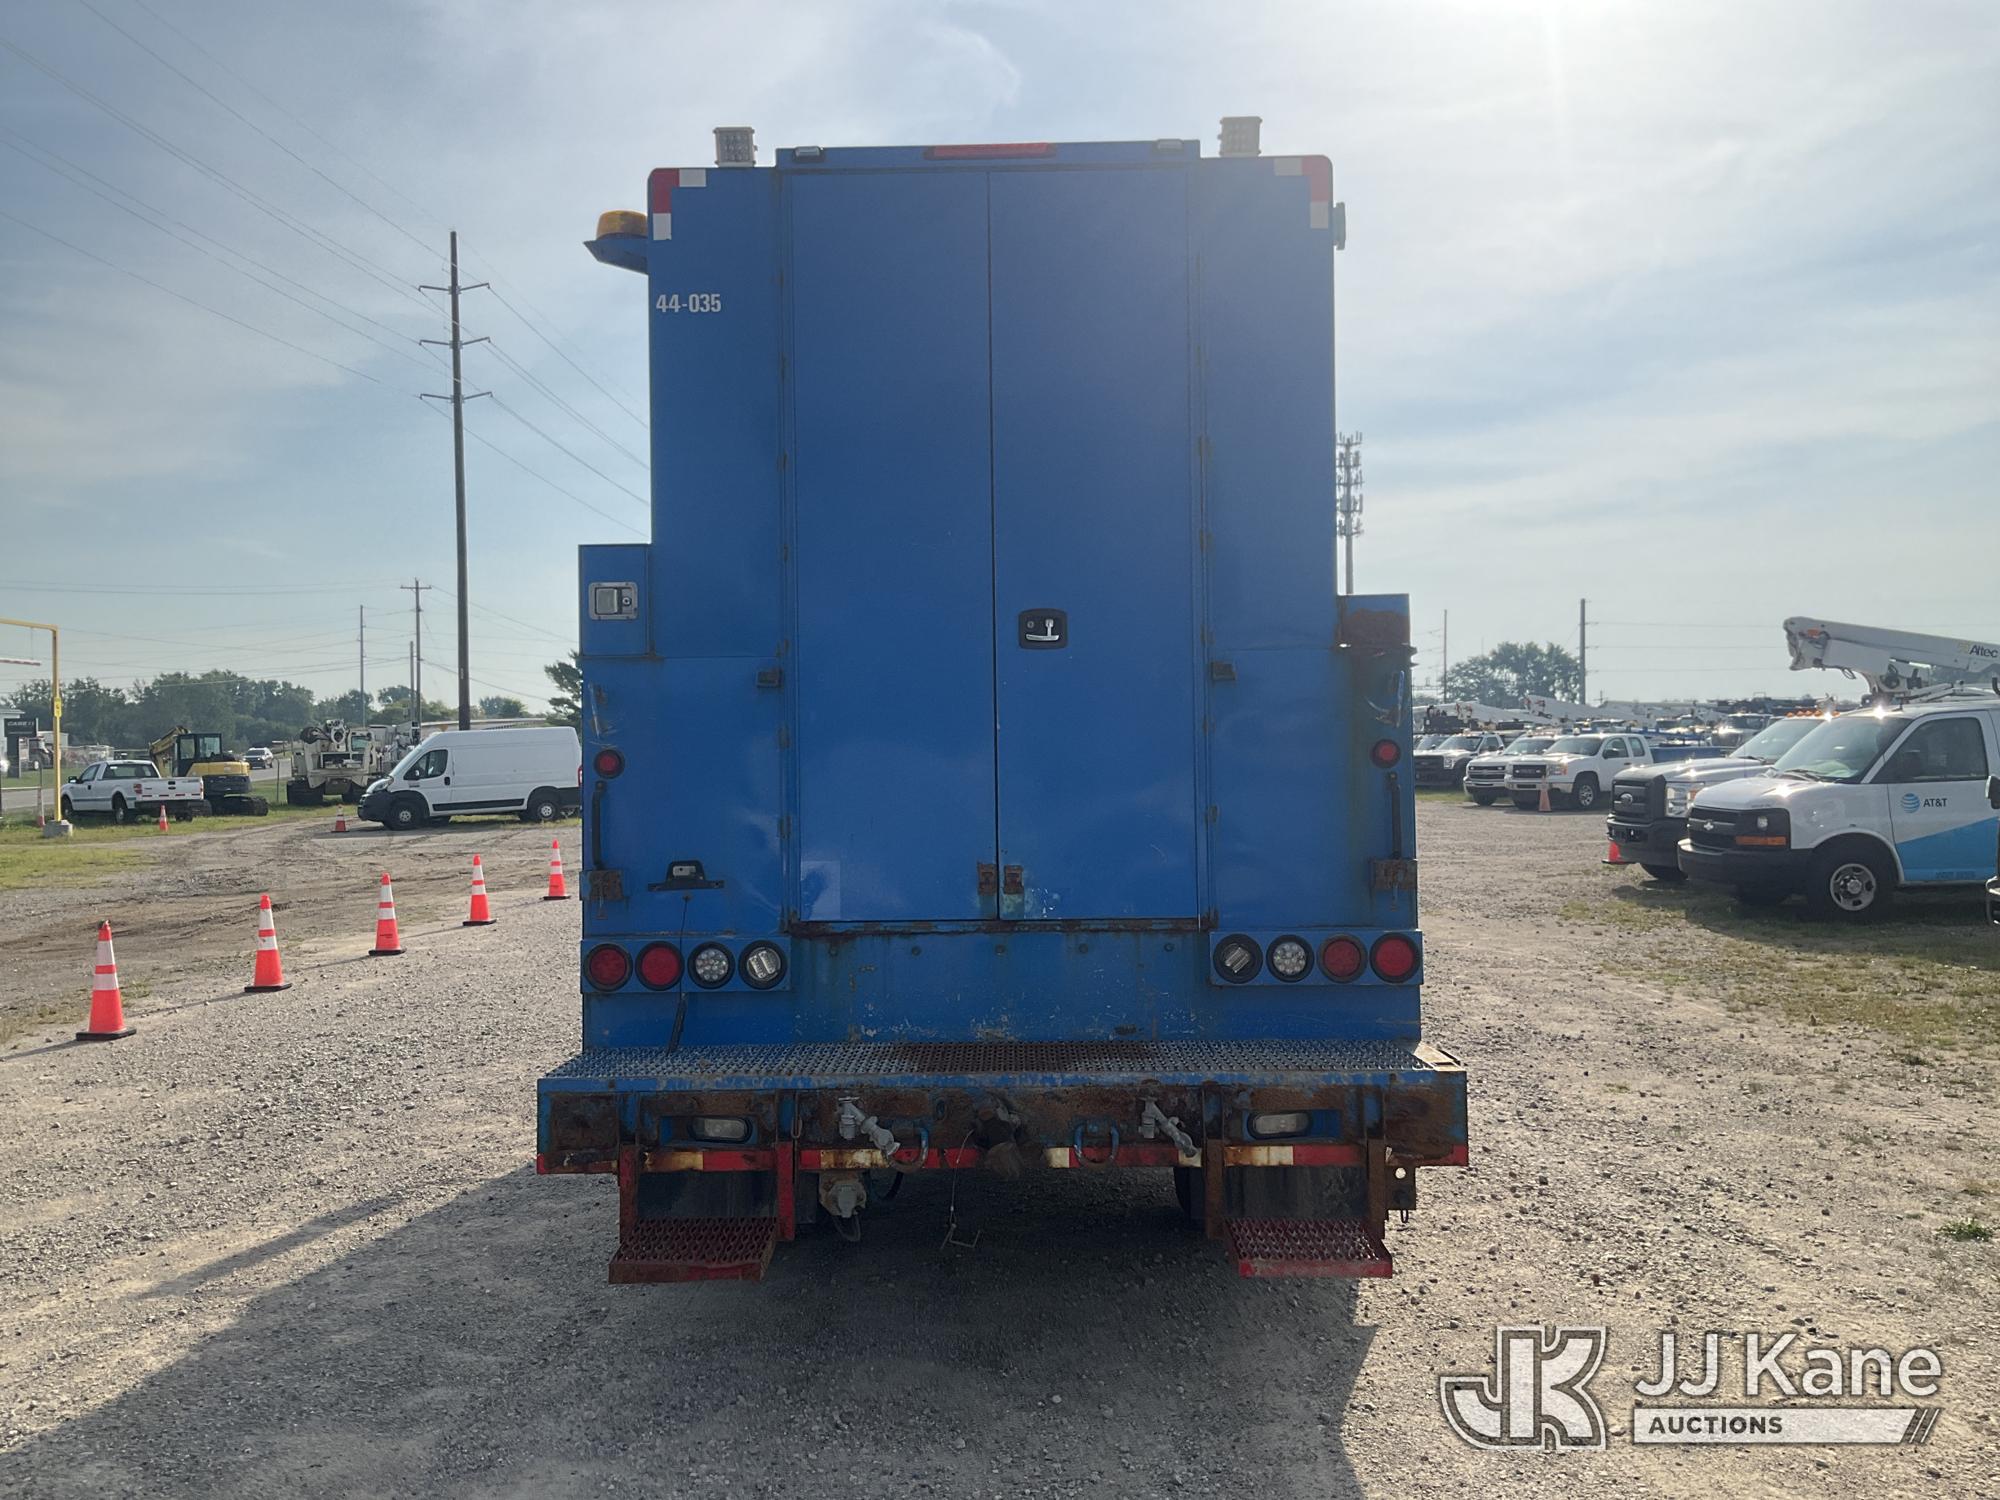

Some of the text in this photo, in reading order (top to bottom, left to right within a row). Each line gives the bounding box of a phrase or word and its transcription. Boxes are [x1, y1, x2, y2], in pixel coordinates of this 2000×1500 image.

[656, 293, 722, 313] 44-035
[1969, 644, 1999, 658] Altec
[1923, 798, 1948, 808] AT&T
